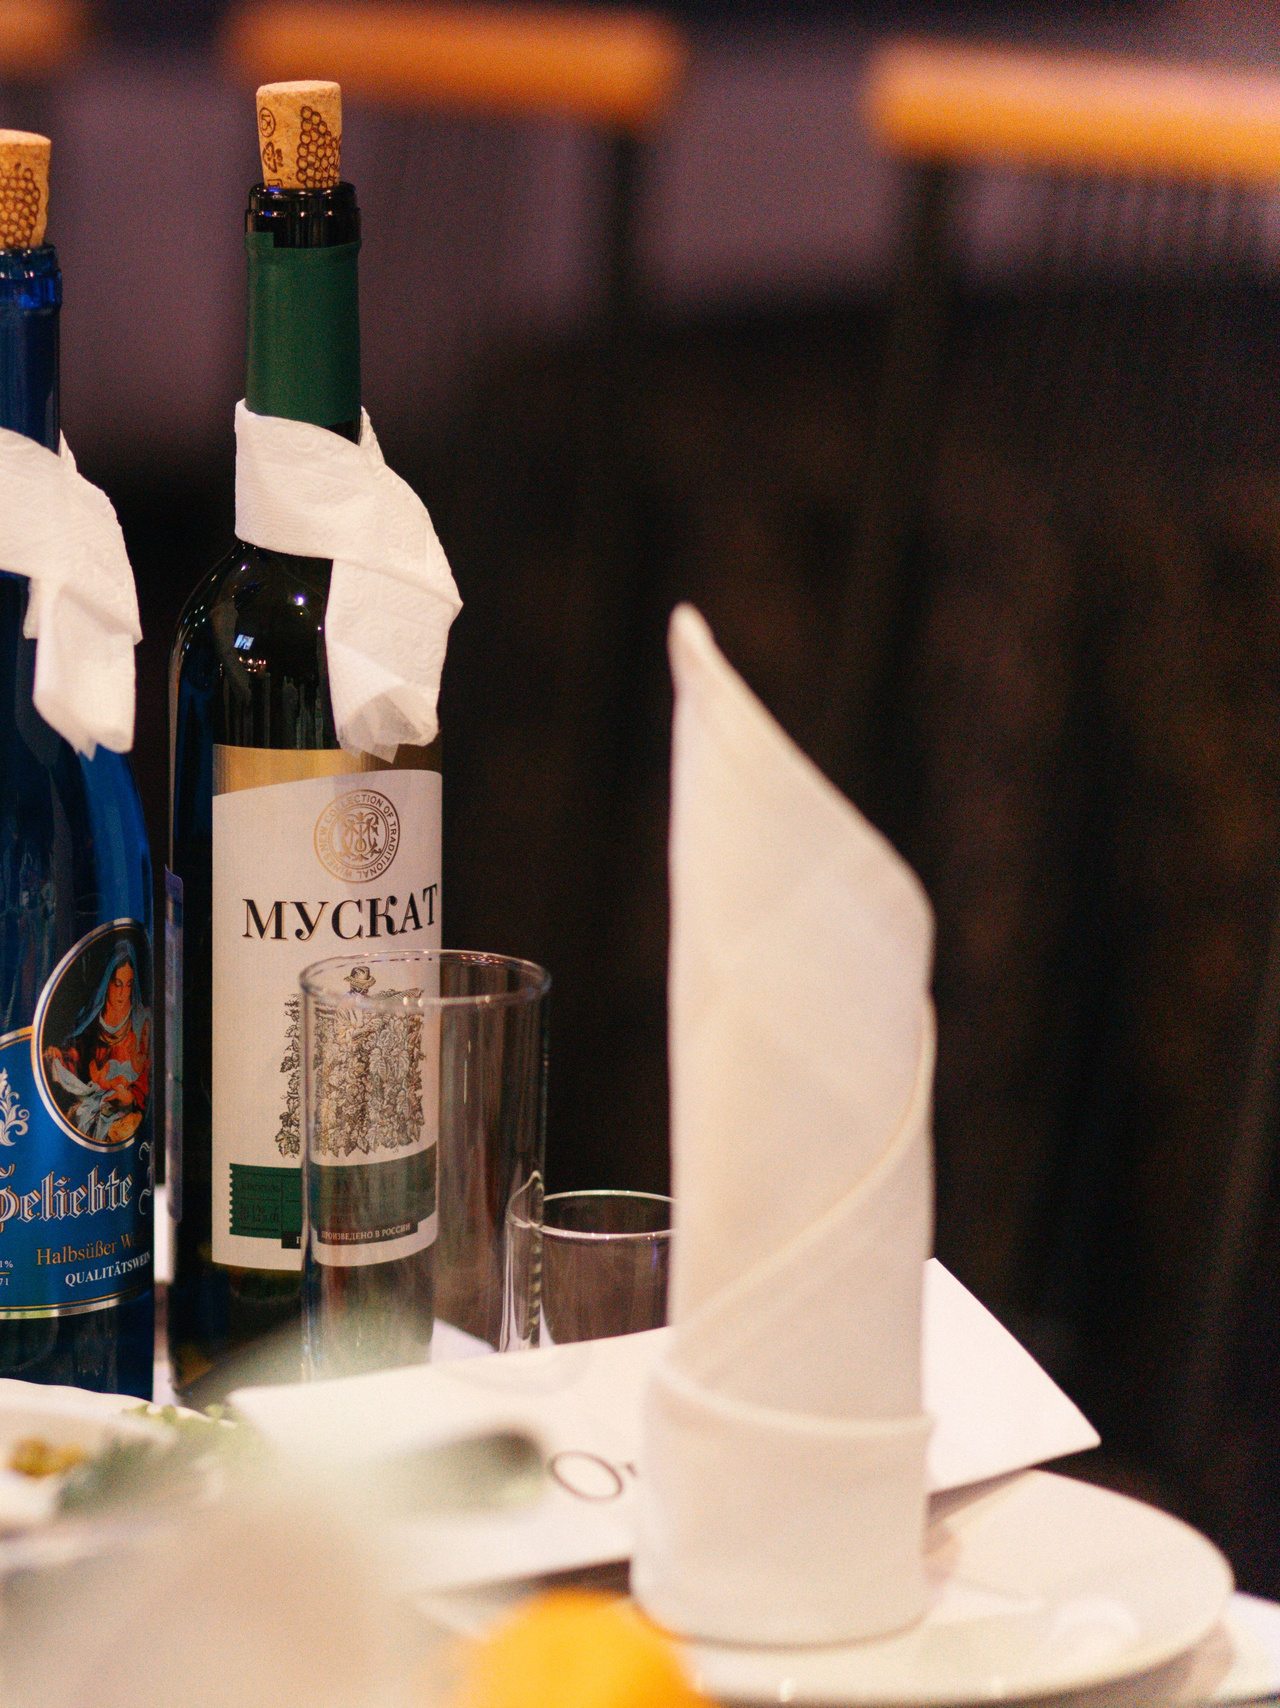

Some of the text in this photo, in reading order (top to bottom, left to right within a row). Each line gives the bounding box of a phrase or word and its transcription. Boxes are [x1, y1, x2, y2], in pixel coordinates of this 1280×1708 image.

[323, 794, 383, 824] COLLECTION
[383, 805, 394, 818] OF
[356, 820, 397, 879] TRADITIONAL
[242, 883, 438, 942] МУСКАТ
[36, 1239, 117, 1266] Halbsüßer
